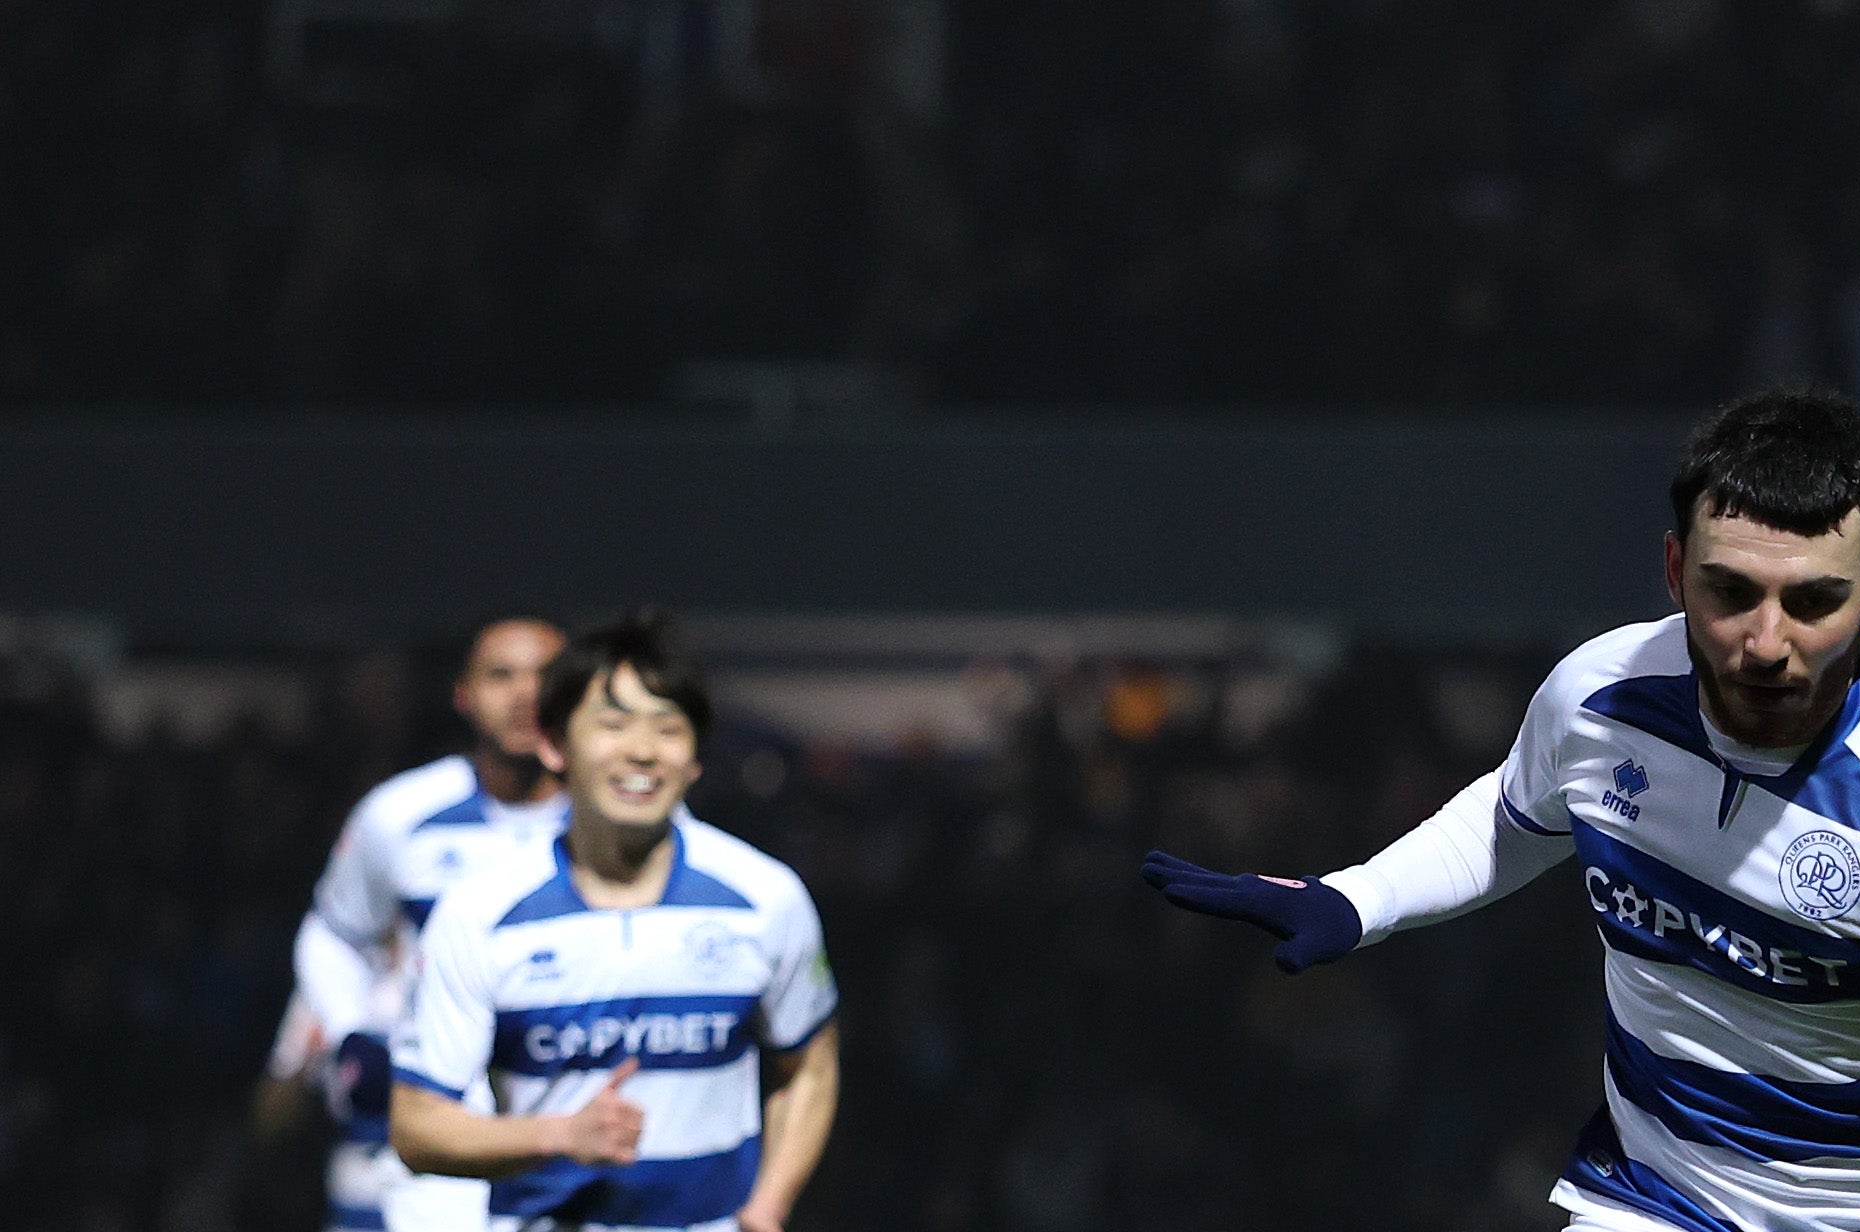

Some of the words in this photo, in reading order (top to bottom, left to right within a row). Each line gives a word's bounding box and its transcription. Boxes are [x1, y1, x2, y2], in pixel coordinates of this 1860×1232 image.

[1601, 789, 1641, 823] errea
[1785, 834, 1816, 865] QUEENS
[1819, 834, 1841, 847] PARK
[1842, 845, 1860, 891] RANGERS
